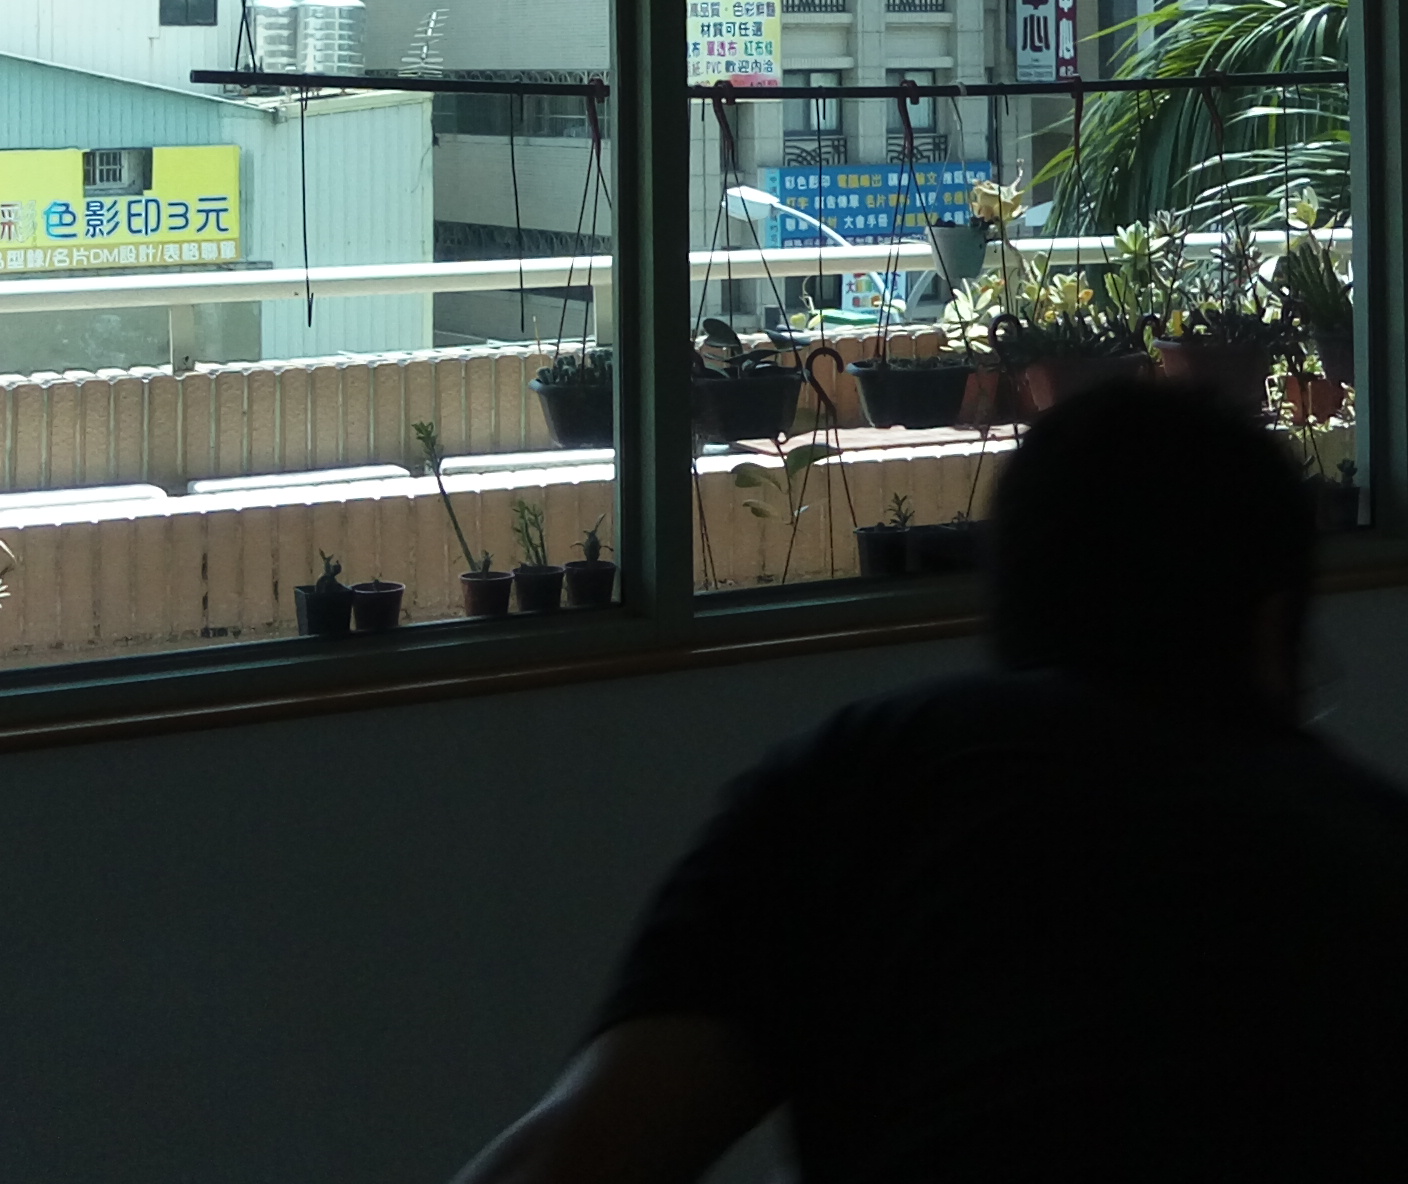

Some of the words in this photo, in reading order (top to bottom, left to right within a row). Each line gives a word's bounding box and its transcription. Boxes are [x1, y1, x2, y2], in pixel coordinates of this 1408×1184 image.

[701, 21, 763, 38] 材質可任選
